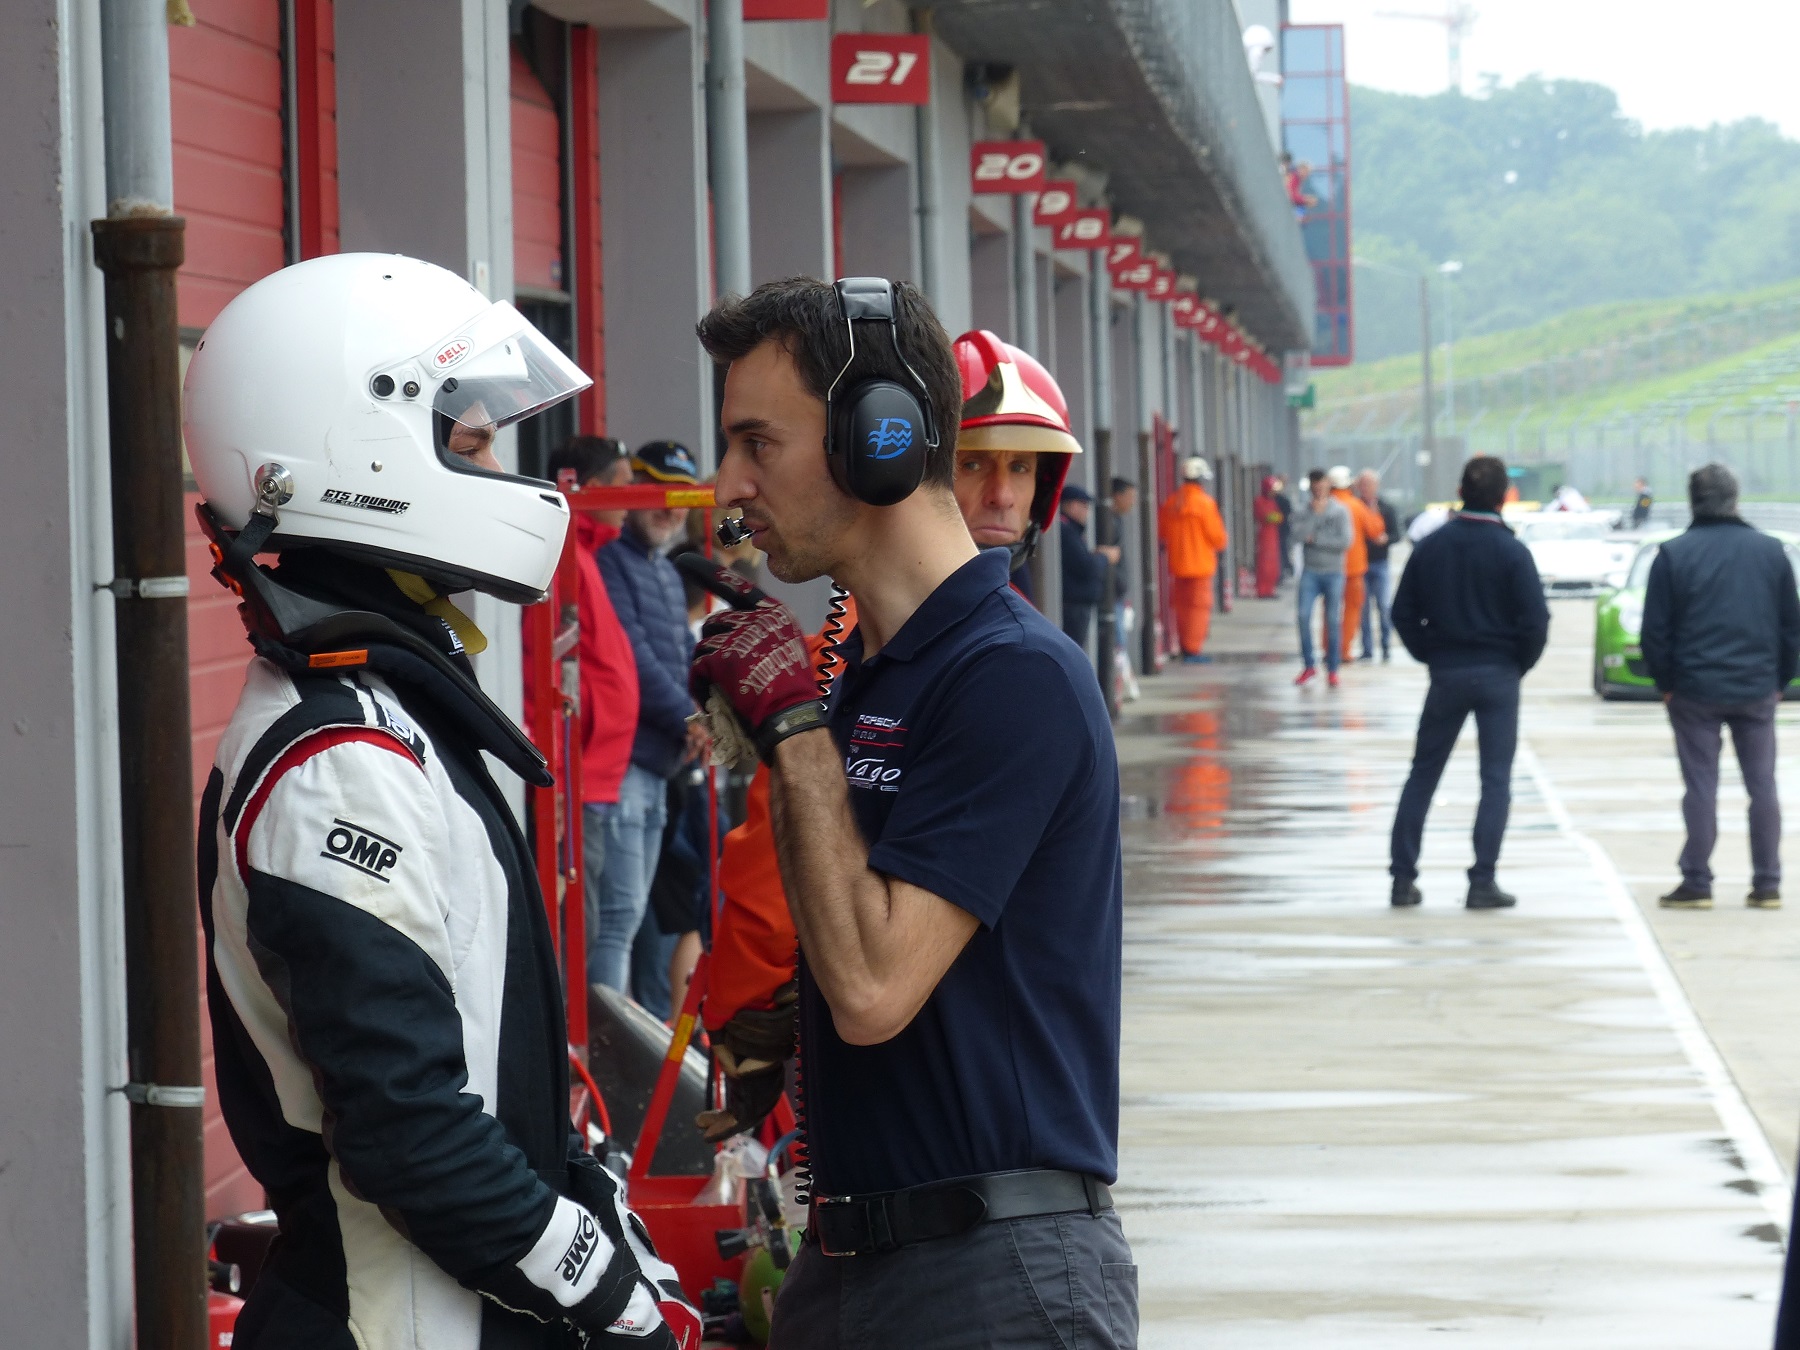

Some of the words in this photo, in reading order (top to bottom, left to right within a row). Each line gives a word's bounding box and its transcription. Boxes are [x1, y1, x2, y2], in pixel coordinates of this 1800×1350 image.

[845, 50, 918, 85] 21
[975, 152, 1043, 180] 20
[437, 343, 466, 364] BELL
[353, 494, 410, 511] TOURING
[326, 827, 398, 873] OMP
[562, 1214, 596, 1282] OMP
